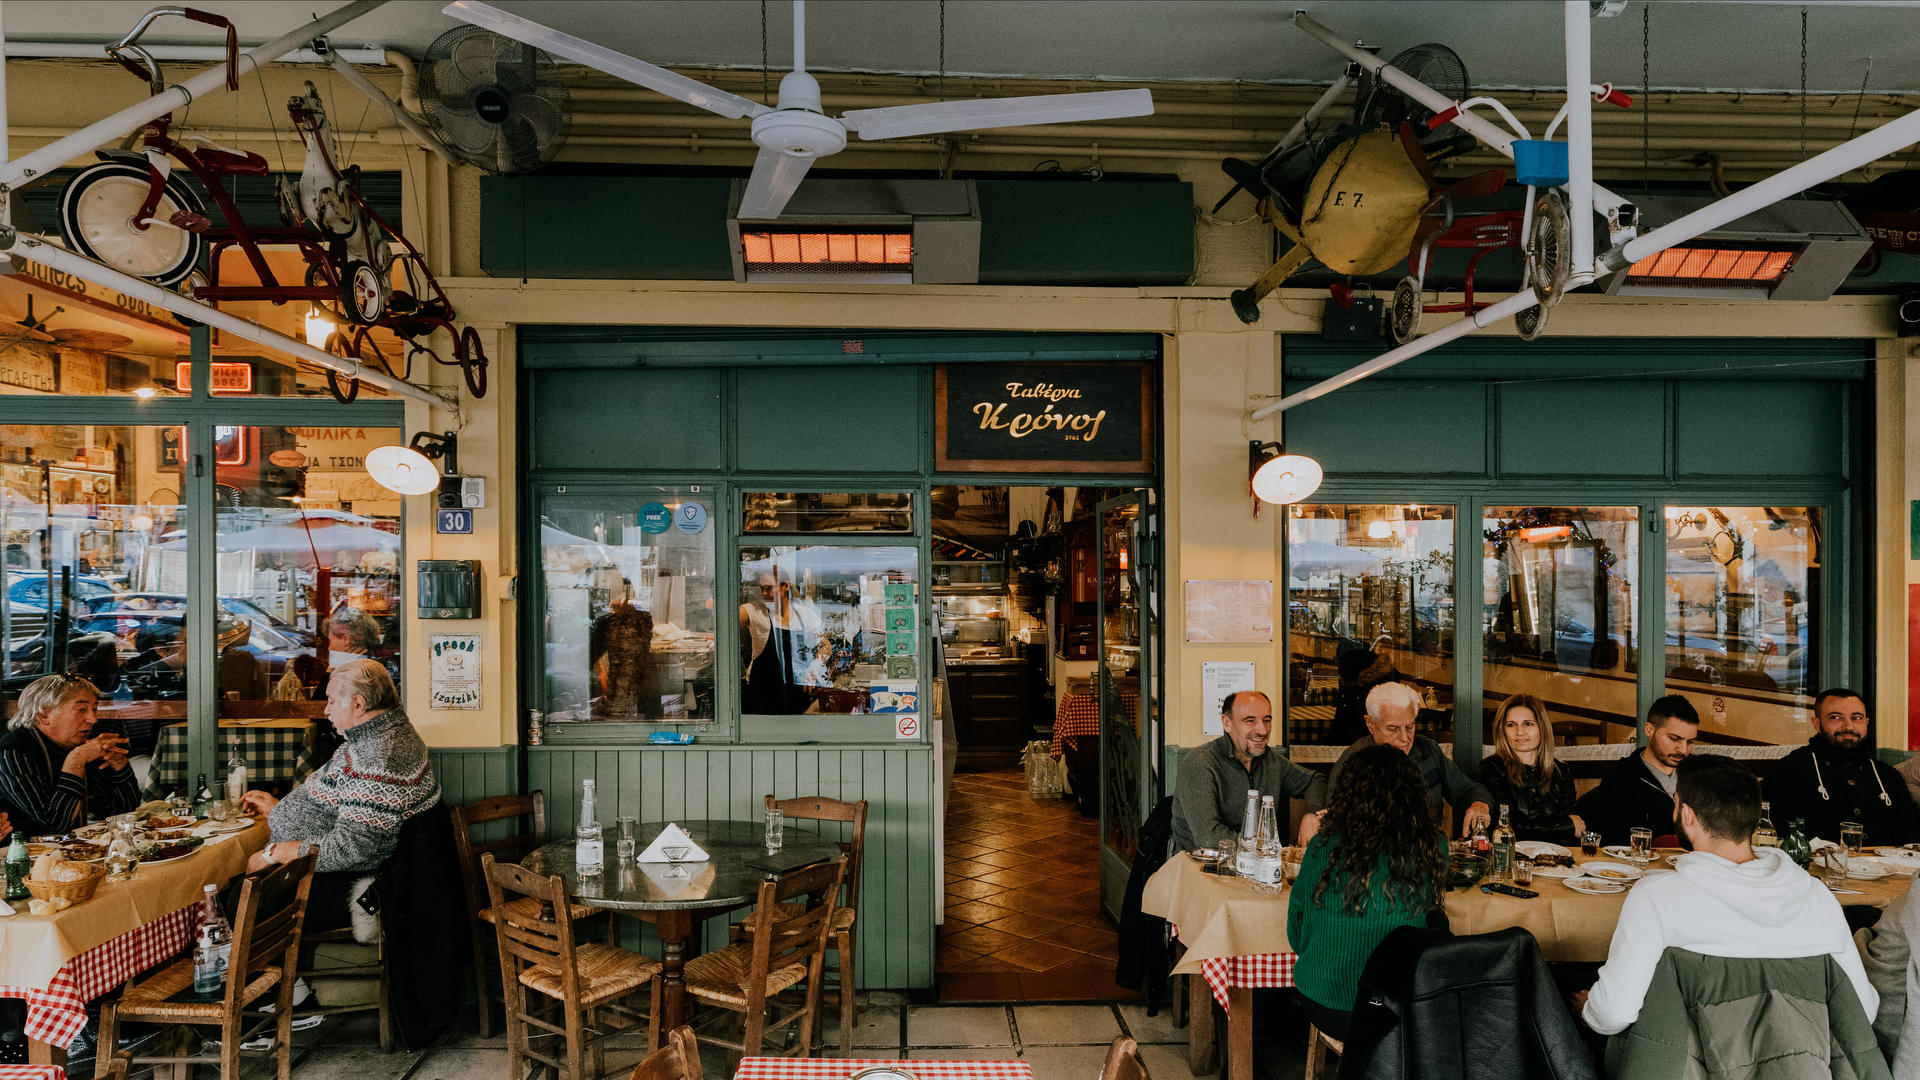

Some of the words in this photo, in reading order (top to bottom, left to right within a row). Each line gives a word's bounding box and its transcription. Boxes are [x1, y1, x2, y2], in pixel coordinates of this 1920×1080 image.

[1005, 382, 1083, 402] Ταβέρνα
[972, 402, 1106, 442] Κρόνος
[329, 456, 366, 467] ΤΣΟΝ
[445, 512, 464, 532] 30
[434, 640, 475, 657] greek
[433, 690, 477, 704] tzatziki
